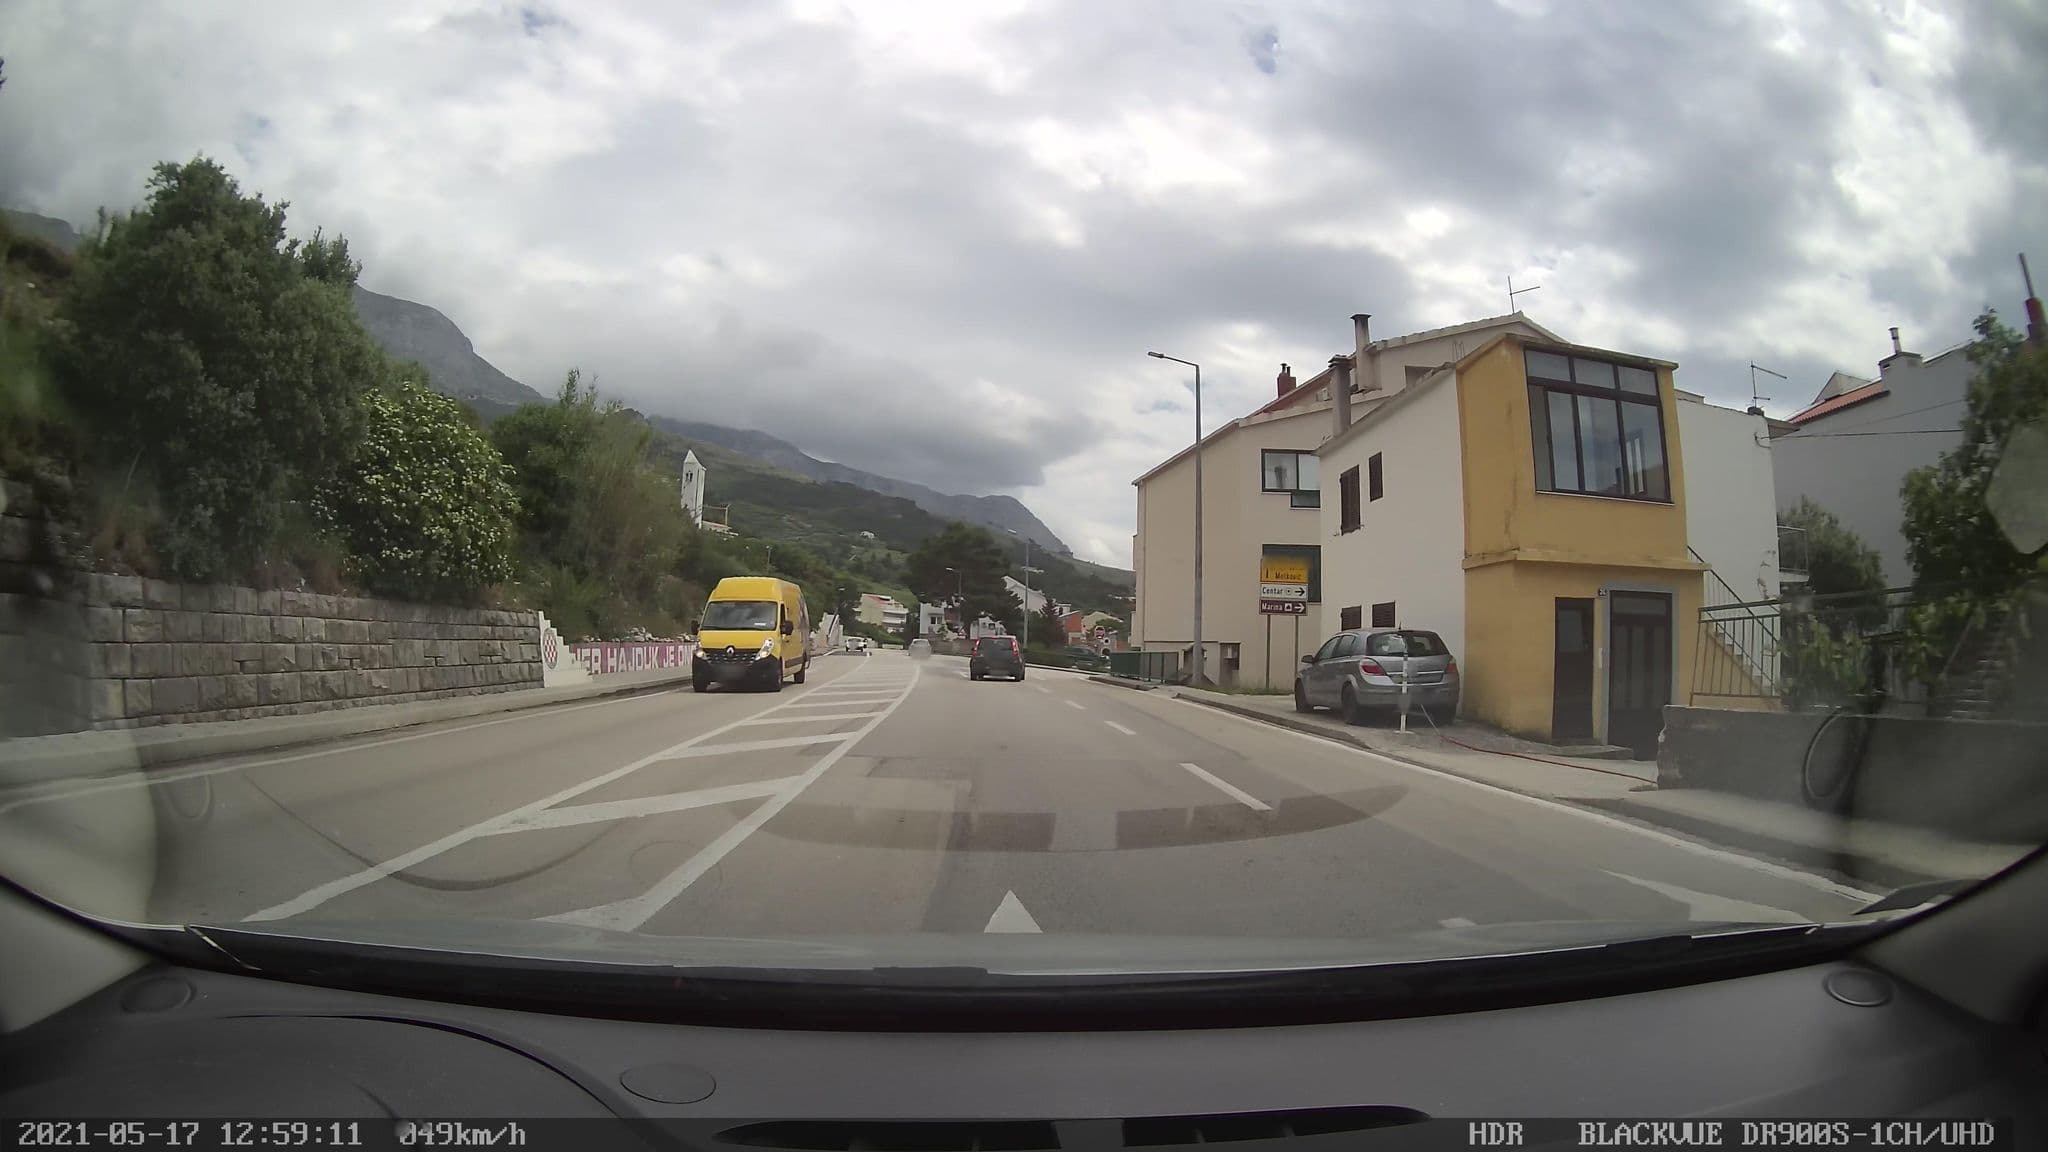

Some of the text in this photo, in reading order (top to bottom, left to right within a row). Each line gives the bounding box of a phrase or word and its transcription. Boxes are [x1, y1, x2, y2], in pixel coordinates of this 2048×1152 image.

[1262, 603, 1283, 611] Marina
[607, 646, 659, 673] HAJDUK
[663, 646, 675, 668] JE
